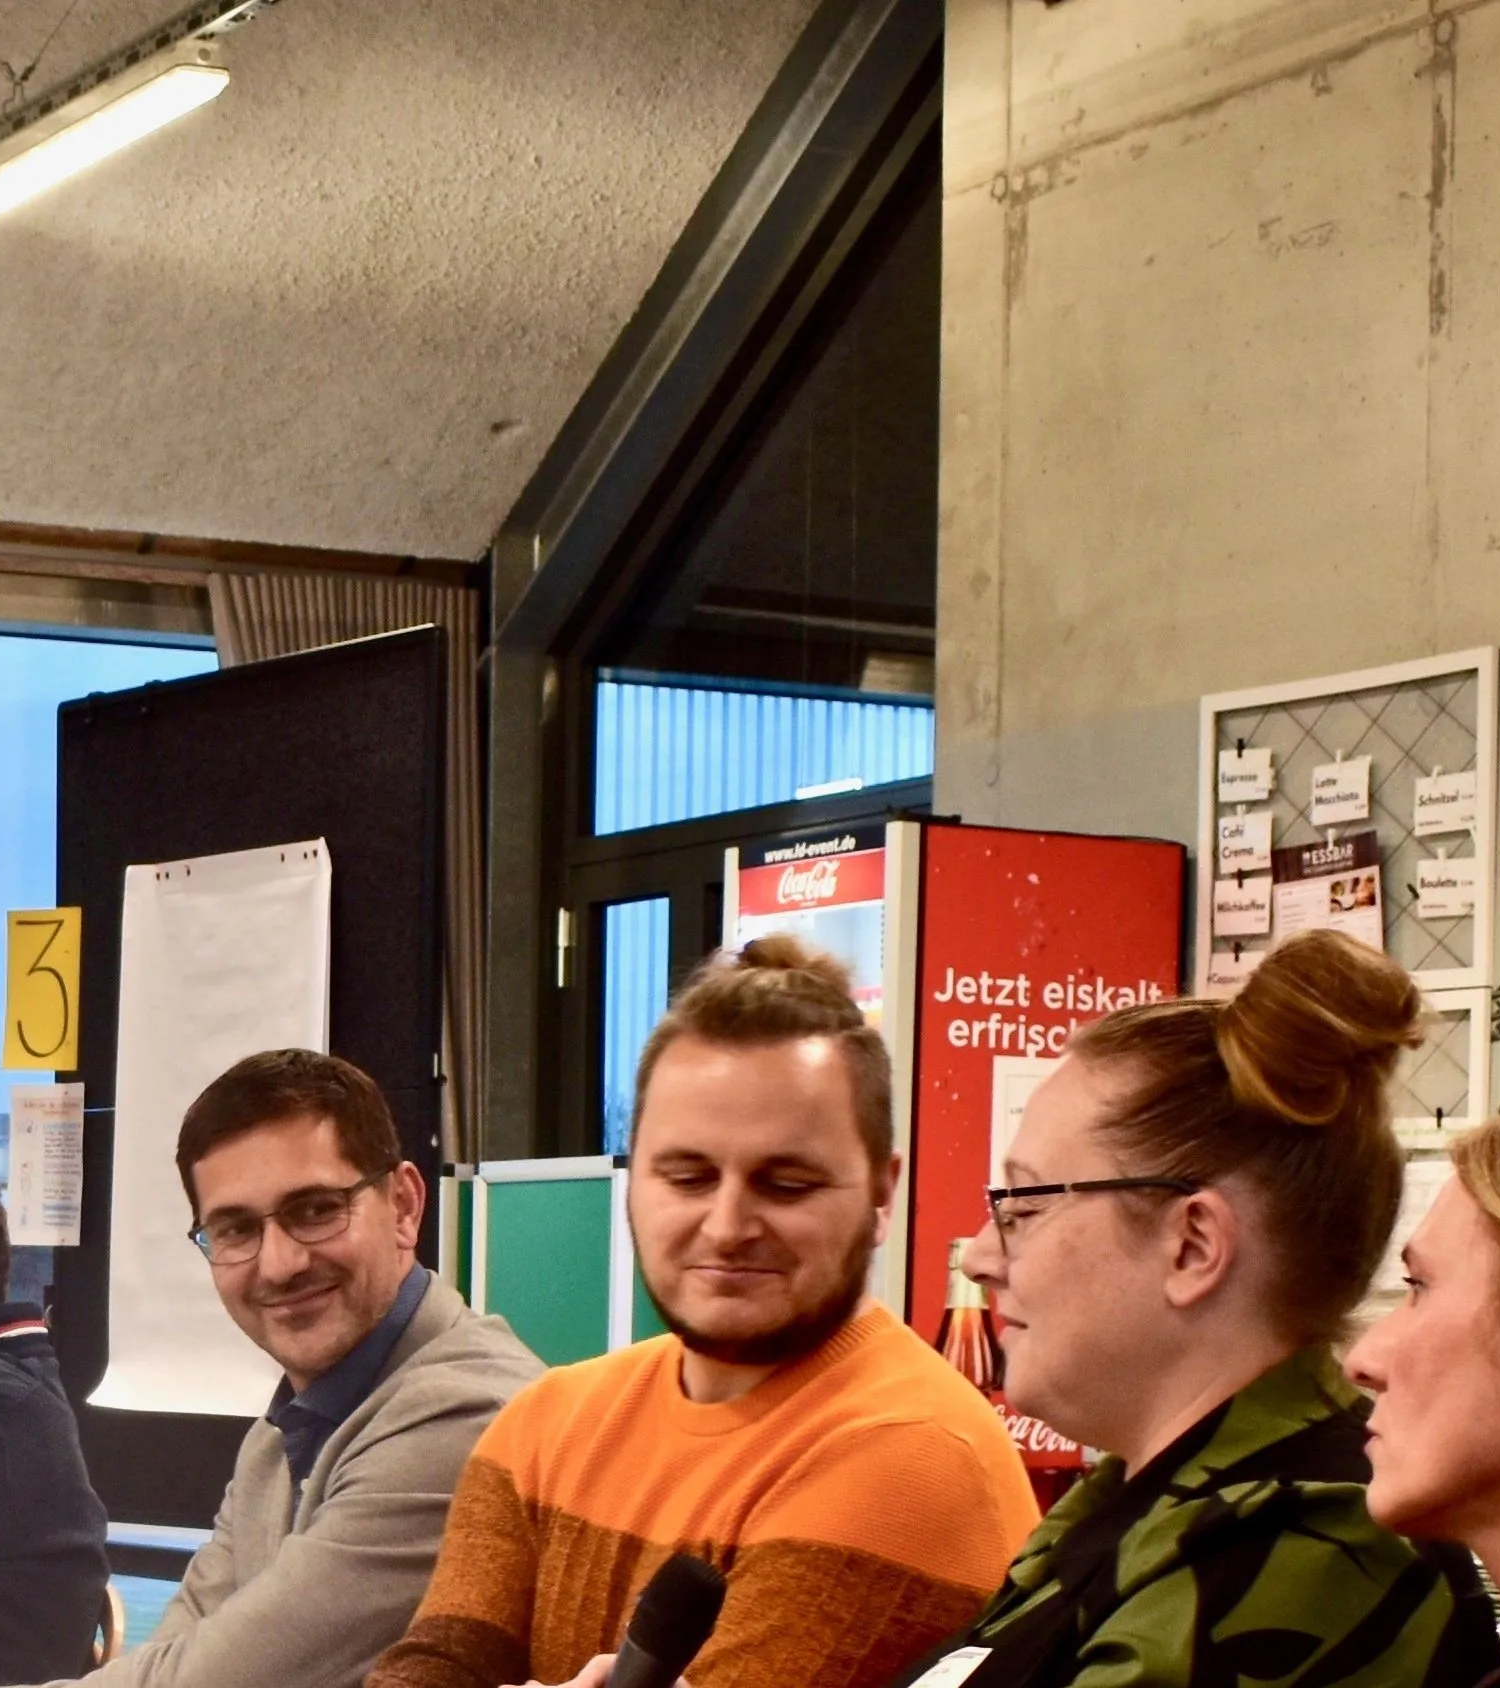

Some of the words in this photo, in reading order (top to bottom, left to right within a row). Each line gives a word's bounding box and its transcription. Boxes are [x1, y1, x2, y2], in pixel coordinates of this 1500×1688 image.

[1418, 789, 1460, 807] Schnitzel
[15, 919, 69, 1058] 3
[934, 967, 1031, 1008] Jetzt
[1043, 974, 1163, 1012] eiskalt
